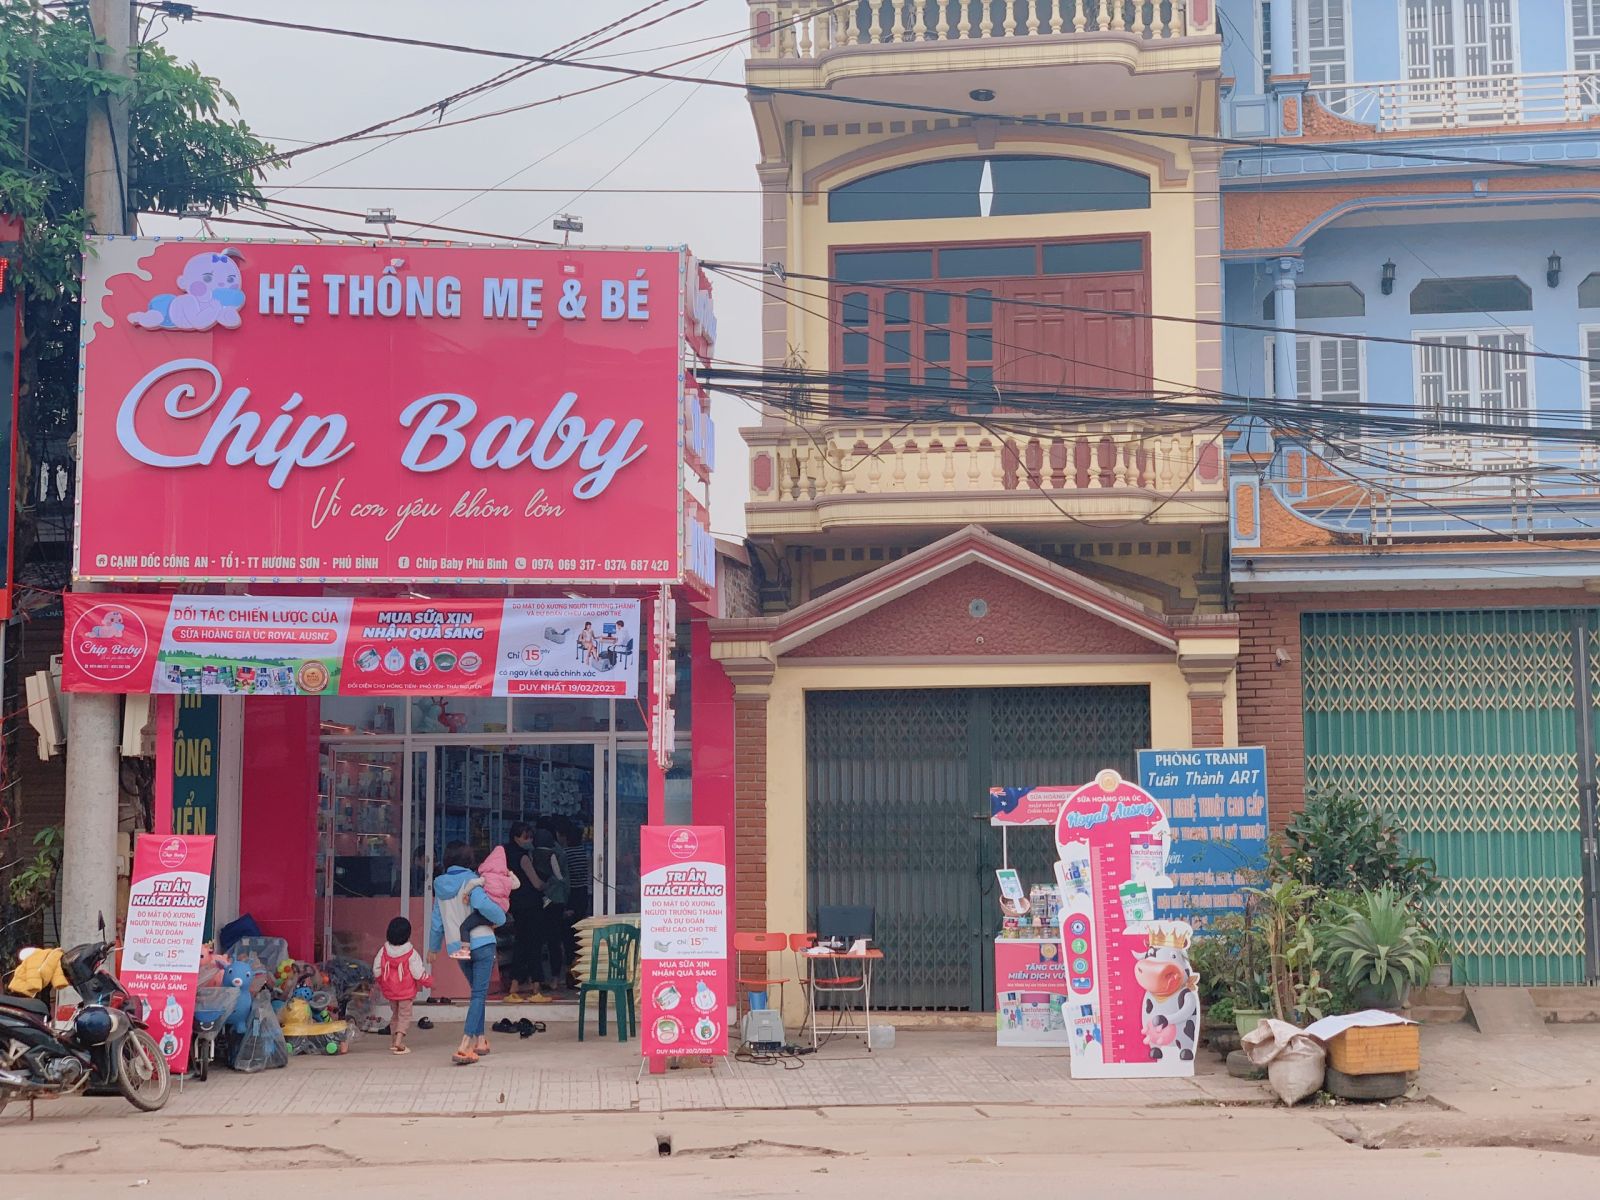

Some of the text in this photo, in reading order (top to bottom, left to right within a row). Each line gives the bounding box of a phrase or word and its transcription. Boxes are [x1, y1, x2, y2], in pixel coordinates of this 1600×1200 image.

[258, 264, 311, 325] HỆ
[323, 257, 462, 319] THỐNG
[483, 277, 543, 330] MẸ
[558, 279, 587, 320] &
[601, 268, 650, 322] BÉ
[115, 358, 356, 490] Chíp
[399, 391, 649, 499] Baby
[311, 477, 566, 541] Vì con yêu khôn lớn
[110, 556, 138, 570] CẠNH
[194, 556, 209, 568] AN
[261, 556, 296, 569] HƯƠNG
[299, 556, 320, 569] SƠN
[332, 554, 352, 569] PHÚ
[355, 554, 379, 569] BÌNH
[440, 557, 463, 571] Baby
[466, 556, 485, 570] Phú
[487, 557, 508, 571] Bình
[532, 559, 670, 572] 0974 069 317 0374 687 420
[173, 605, 339, 625] ĐỐI TÁC CHIẾN LƯỢC CỦA
[378, 611, 412, 624] MUA
[414, 608, 444, 624] SỮA
[180, 628, 330, 641] SỮA HOÀNG GIA ÚC ROYAL AUSNZ
[363, 623, 408, 642] NHẬN
[112, 644, 142, 657] Baby
[525, 649, 540, 661] 15
[509, 669, 528, 679] ngay
[530, 668, 542, 676] kết
[543, 669, 560, 679] quả
[519, 681, 616, 693] DUY NHẤT 19/02/2023
[1155, 752, 1248, 767] PHÒNG TRANH
[1185, 771, 1224, 786] Thành
[1229, 769, 1260, 785] ART
[1076, 795, 1091, 803] SỮA
[1091, 794, 1117, 803] HOÀNG
[1132, 794, 1142, 802] ÚC
[1066, 803, 1108, 829] Royal
[666, 867, 706, 882] TRI ÂN
[154, 876, 191, 893] TRI ÂN
[644, 881, 724, 896] KHÁCH HÀNG
[131, 892, 205, 908] KHÁCH HÀNG
[690, 937, 702, 946] 15
[167, 949, 178, 959] 15
[678, 959, 695, 968] SỮA
[135, 973, 153, 981] MUA
[153, 972, 168, 981] SỮA
